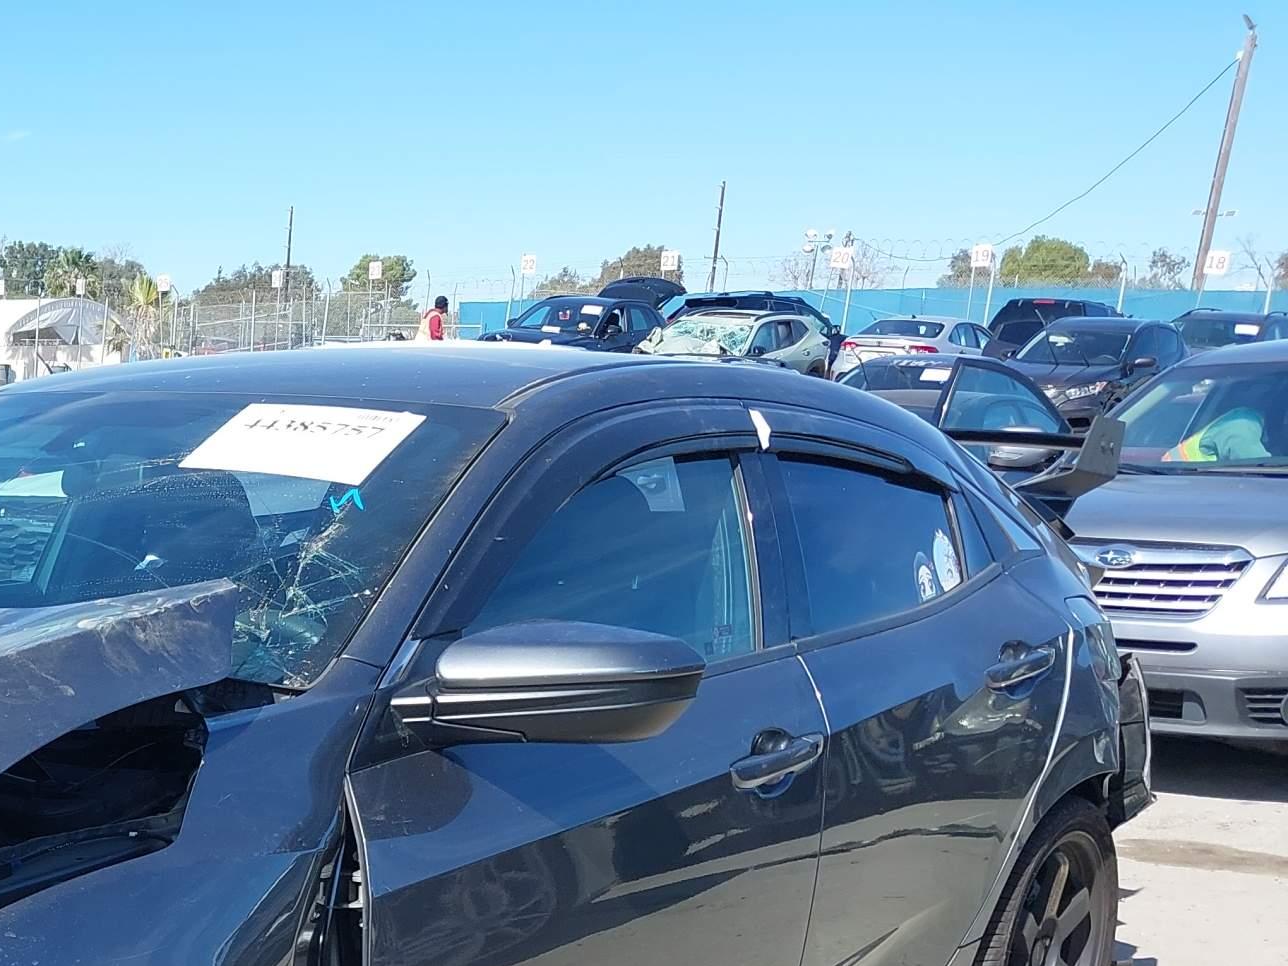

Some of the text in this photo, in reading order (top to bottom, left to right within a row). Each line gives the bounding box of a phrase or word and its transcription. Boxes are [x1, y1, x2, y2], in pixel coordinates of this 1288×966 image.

[662, 255, 676, 267] 21
[832, 250, 849, 264] 20
[974, 249, 990, 262] 19
[522, 258, 535, 270] 22
[1206, 255, 1226, 270] 18
[243, 417, 386, 439] 44385757
